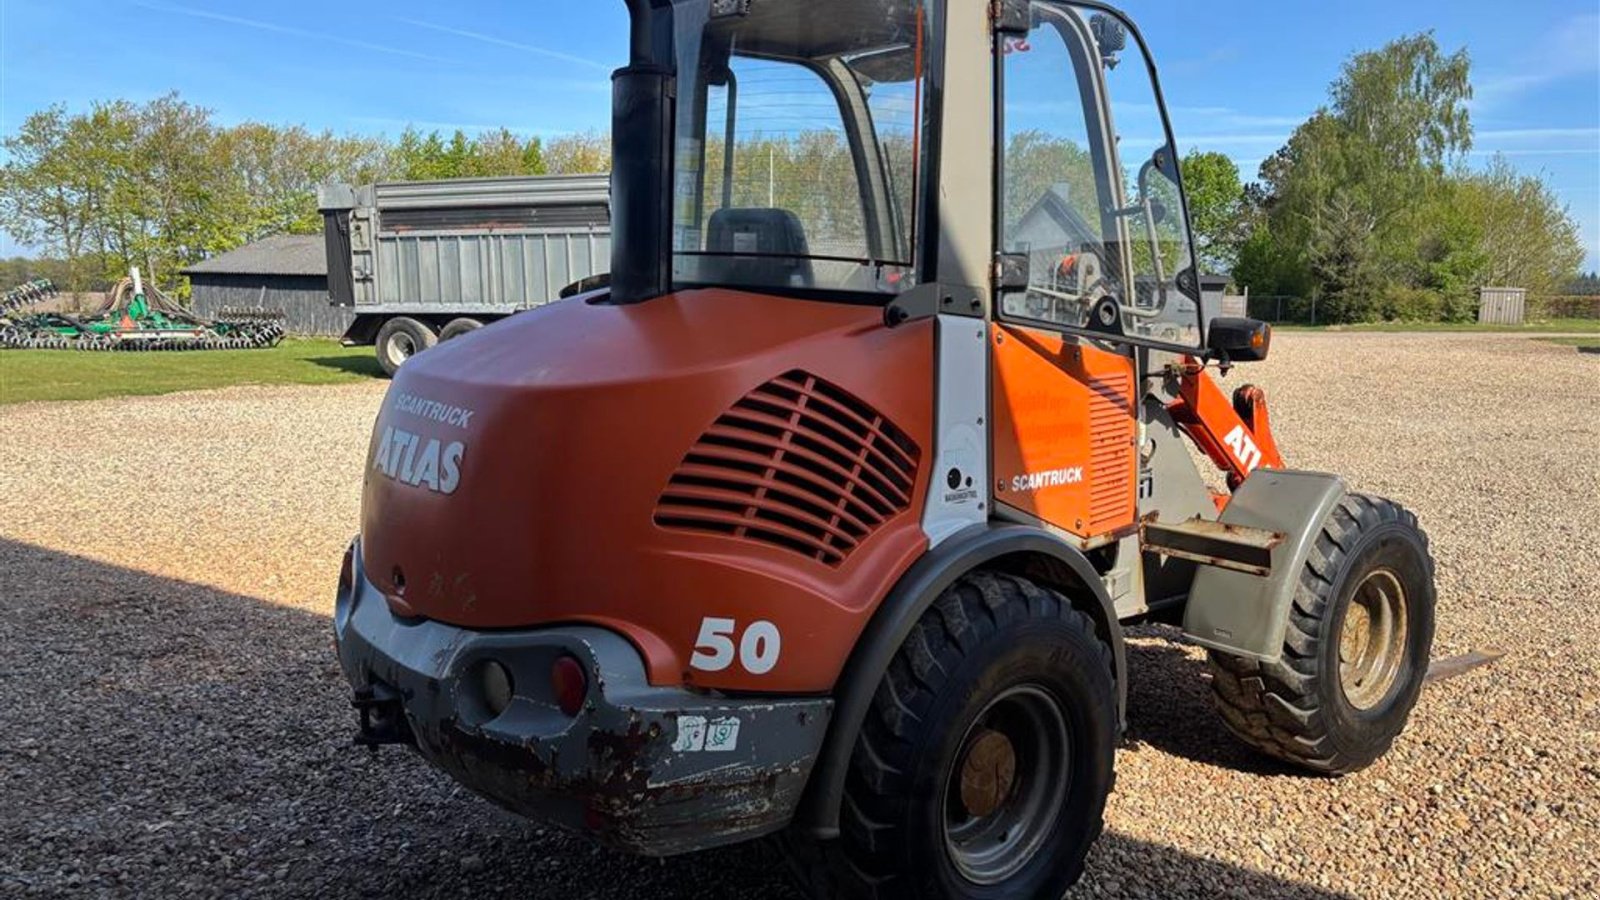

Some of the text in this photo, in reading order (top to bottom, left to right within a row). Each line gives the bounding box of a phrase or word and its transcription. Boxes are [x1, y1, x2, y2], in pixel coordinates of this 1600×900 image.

[395, 393, 474, 429] SCANTRUCK
[373, 425, 466, 496] ATLAS
[1012, 467, 1084, 492] SCANTRUCK
[690, 616, 781, 675] 50
